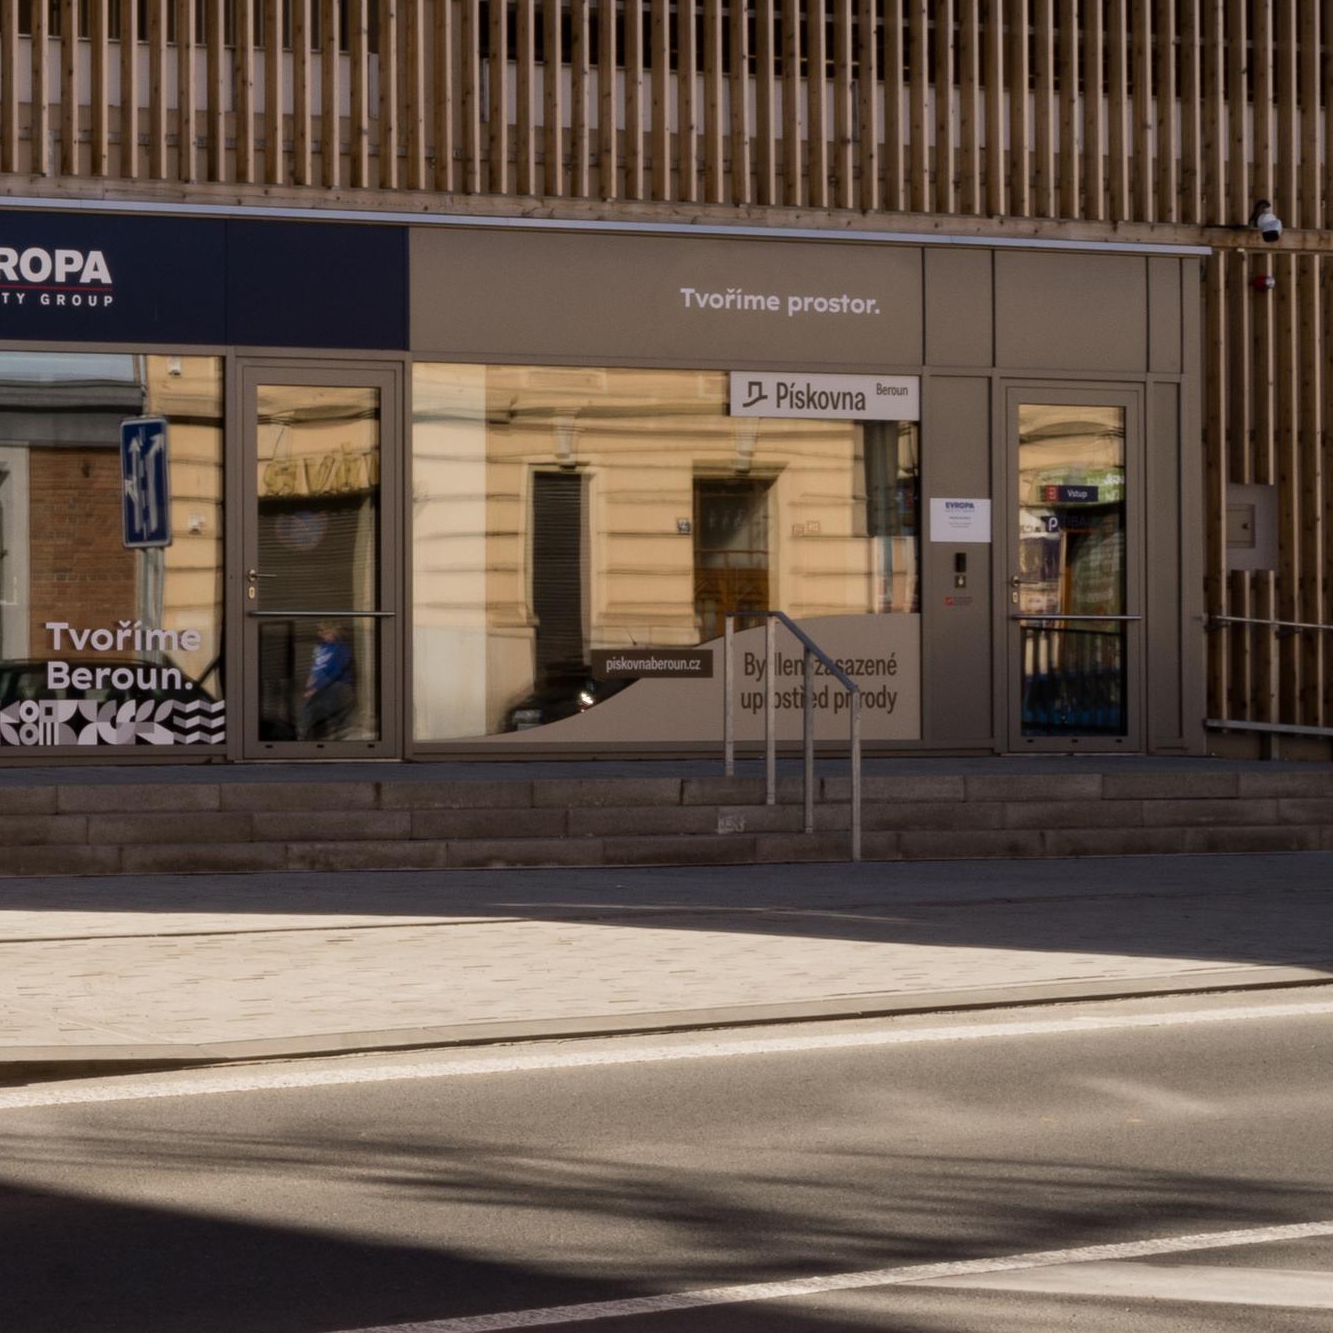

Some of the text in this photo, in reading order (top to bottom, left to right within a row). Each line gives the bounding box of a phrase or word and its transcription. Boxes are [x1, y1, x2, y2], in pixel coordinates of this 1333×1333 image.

[40, 293, 113, 307] GROUP
[679, 287, 881, 317] Tvoříme prostor.
[775, 381, 909, 411] Pískovna Beroun
[45, 619, 202, 652] Tvoříme
[47, 660, 194, 690] Beroun.
[605, 655, 702, 673] piskovnaberoun.cz
[744, 652, 809, 682] Bylen
[741, 685, 898, 715] upostd prody
